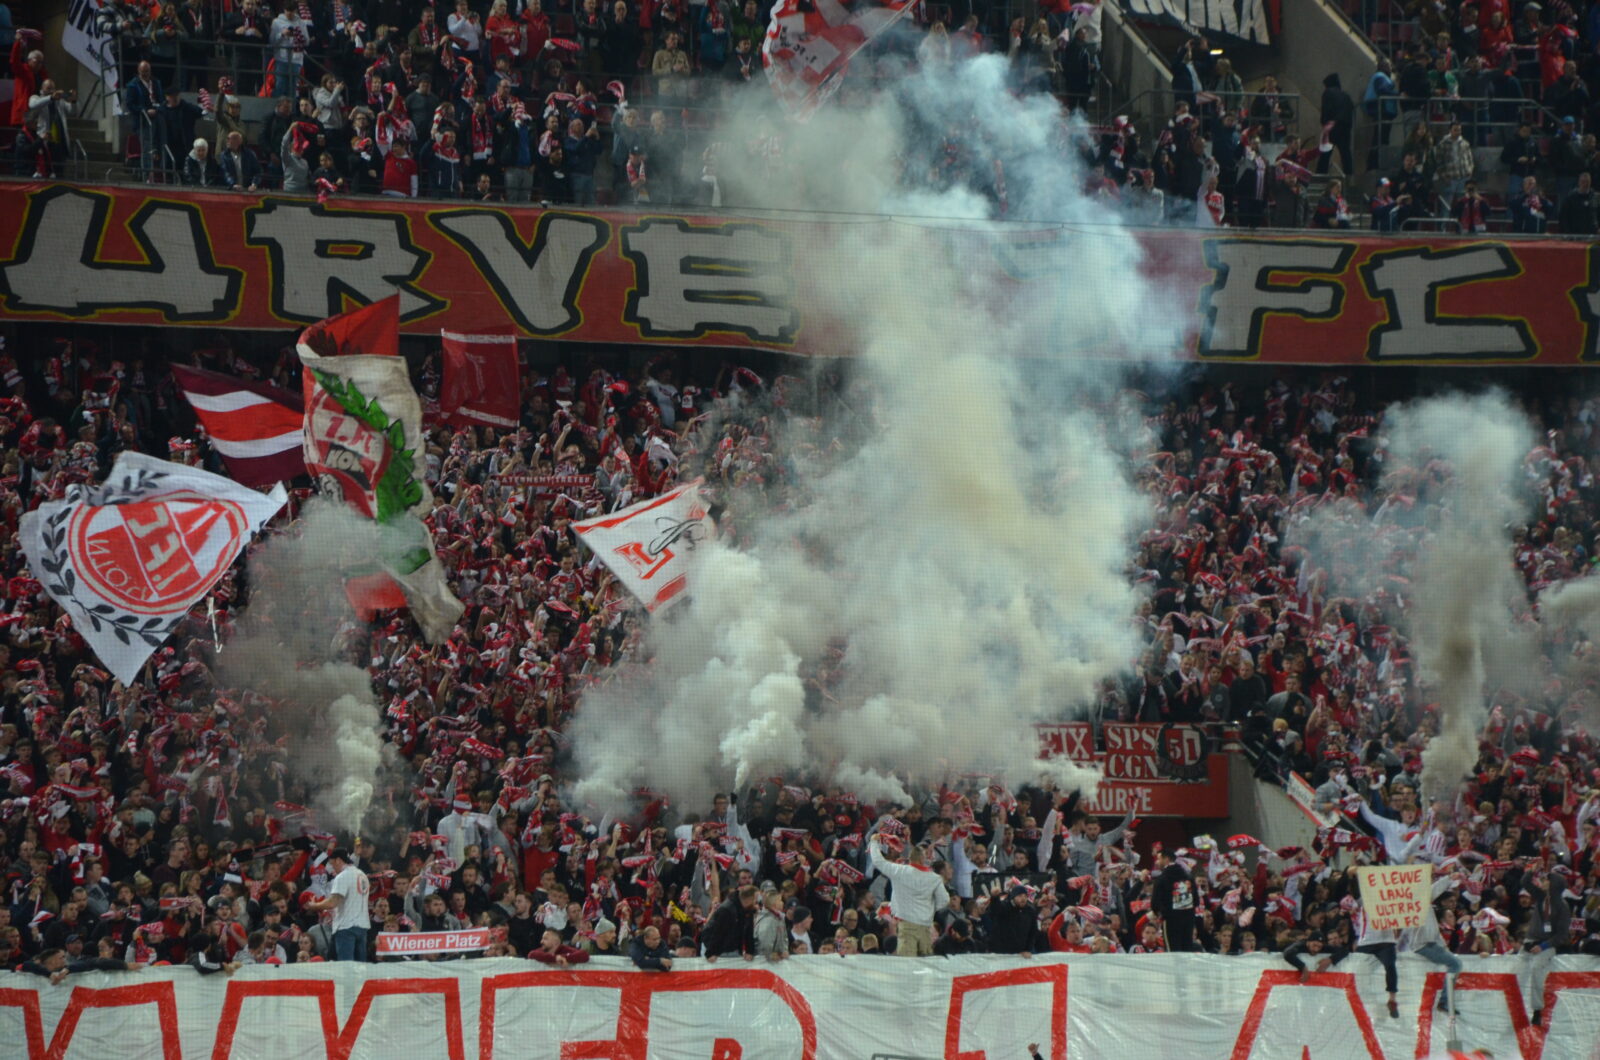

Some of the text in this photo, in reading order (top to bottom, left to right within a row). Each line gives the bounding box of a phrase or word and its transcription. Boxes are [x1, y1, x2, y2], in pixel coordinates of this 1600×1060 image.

[1106, 726, 1157, 751] SPS
[1367, 874, 1376, 886] E
[1379, 887, 1414, 901] LANG
[1375, 901, 1422, 916] ULTRAS
[1404, 916, 1420, 927] FC
[386, 934, 481, 950] Wiener Platz
